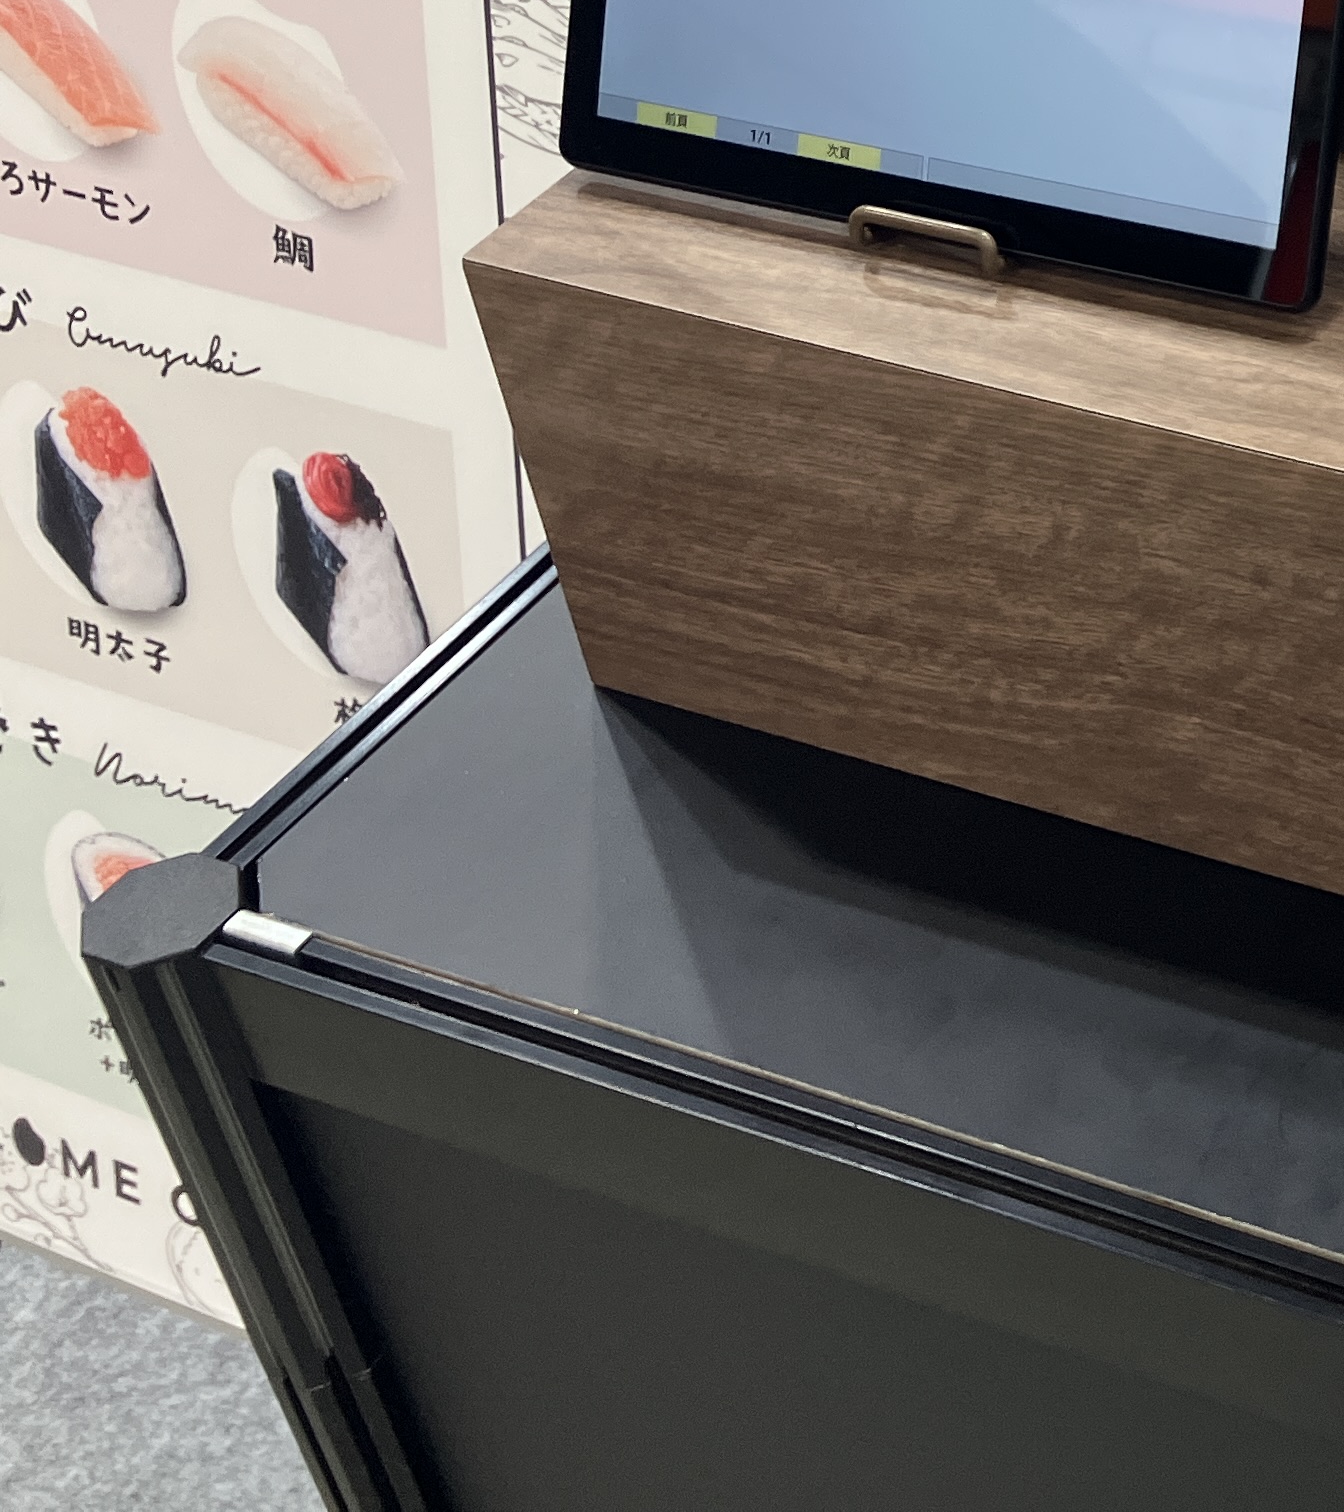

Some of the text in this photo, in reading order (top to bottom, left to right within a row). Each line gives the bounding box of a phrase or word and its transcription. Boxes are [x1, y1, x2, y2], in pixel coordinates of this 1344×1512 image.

[749, 129, 772, 146] 1/1
[1, 160, 150, 224] ろサーモン
[272, 224, 314, 272] 鯛
[67, 617, 171, 673] 明太子
